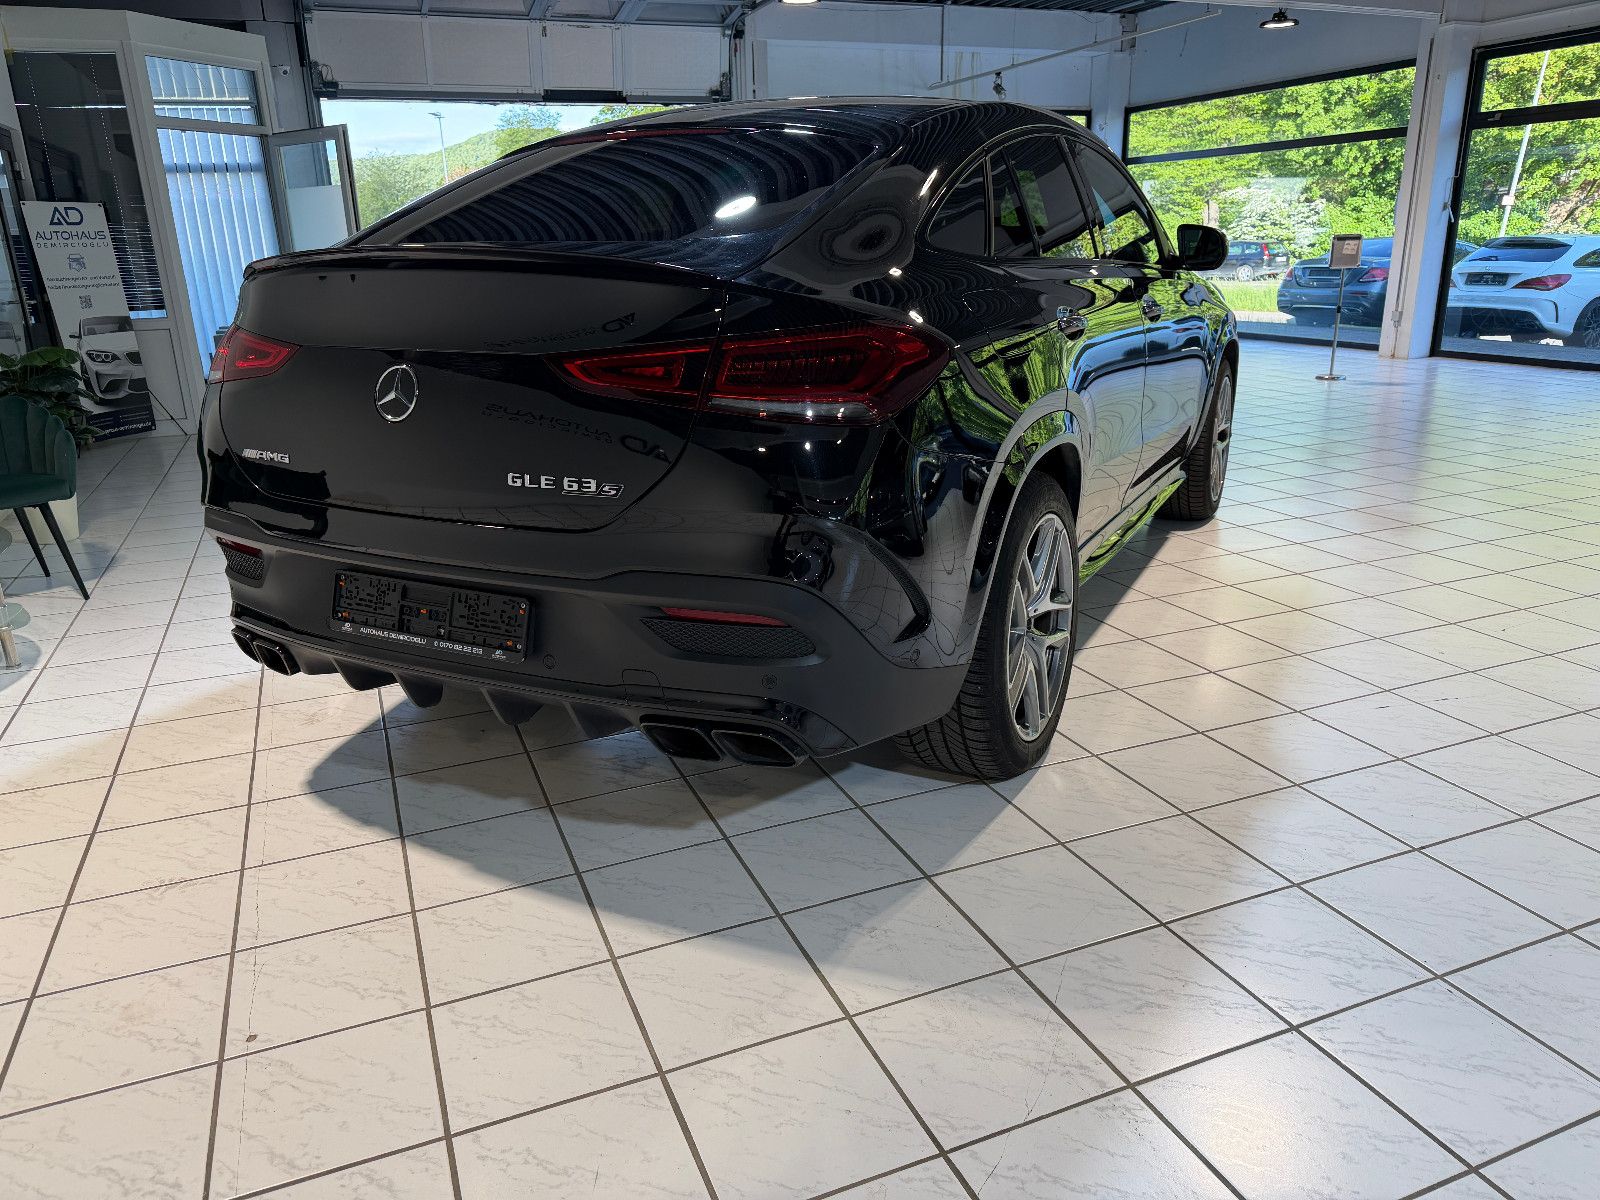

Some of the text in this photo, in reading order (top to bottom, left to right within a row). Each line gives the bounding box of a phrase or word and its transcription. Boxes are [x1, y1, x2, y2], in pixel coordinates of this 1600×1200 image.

[49, 206, 84, 226] AD
[35, 230, 107, 241] AUTOHAUS
[256, 449, 290, 464] AMG
[507, 472, 556, 489] GLE
[359, 627, 389, 638] AUTOHAUS
[389, 632, 427, 645] DEMIRCIOGLU
[439, 641, 453, 649] 0170
